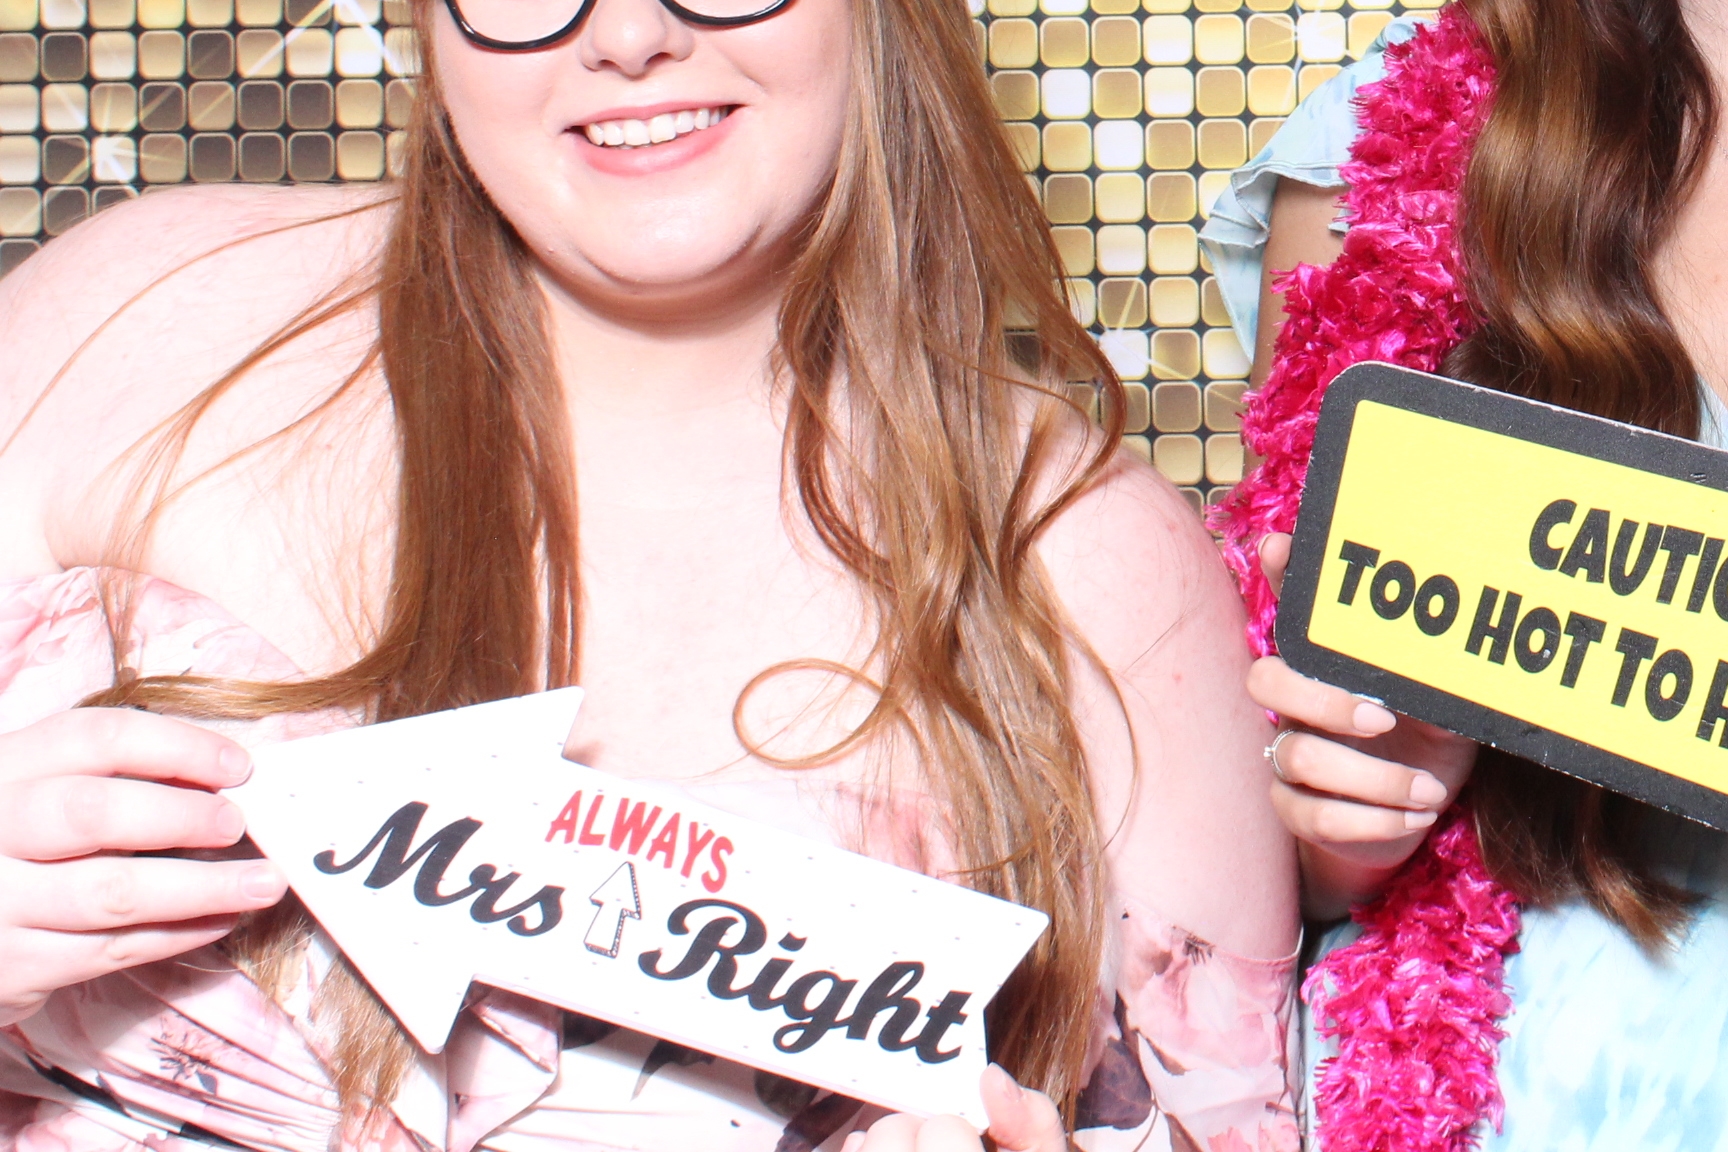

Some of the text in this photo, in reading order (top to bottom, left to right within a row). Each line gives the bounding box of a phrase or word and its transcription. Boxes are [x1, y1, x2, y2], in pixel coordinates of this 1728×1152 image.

[1337, 539, 1460, 637] TOO
[1464, 585, 1607, 689] HOT
[1611, 627, 1694, 722] TO
[313, 801, 974, 1065] Mrs Right
[545, 789, 735, 894] ALWAYS
